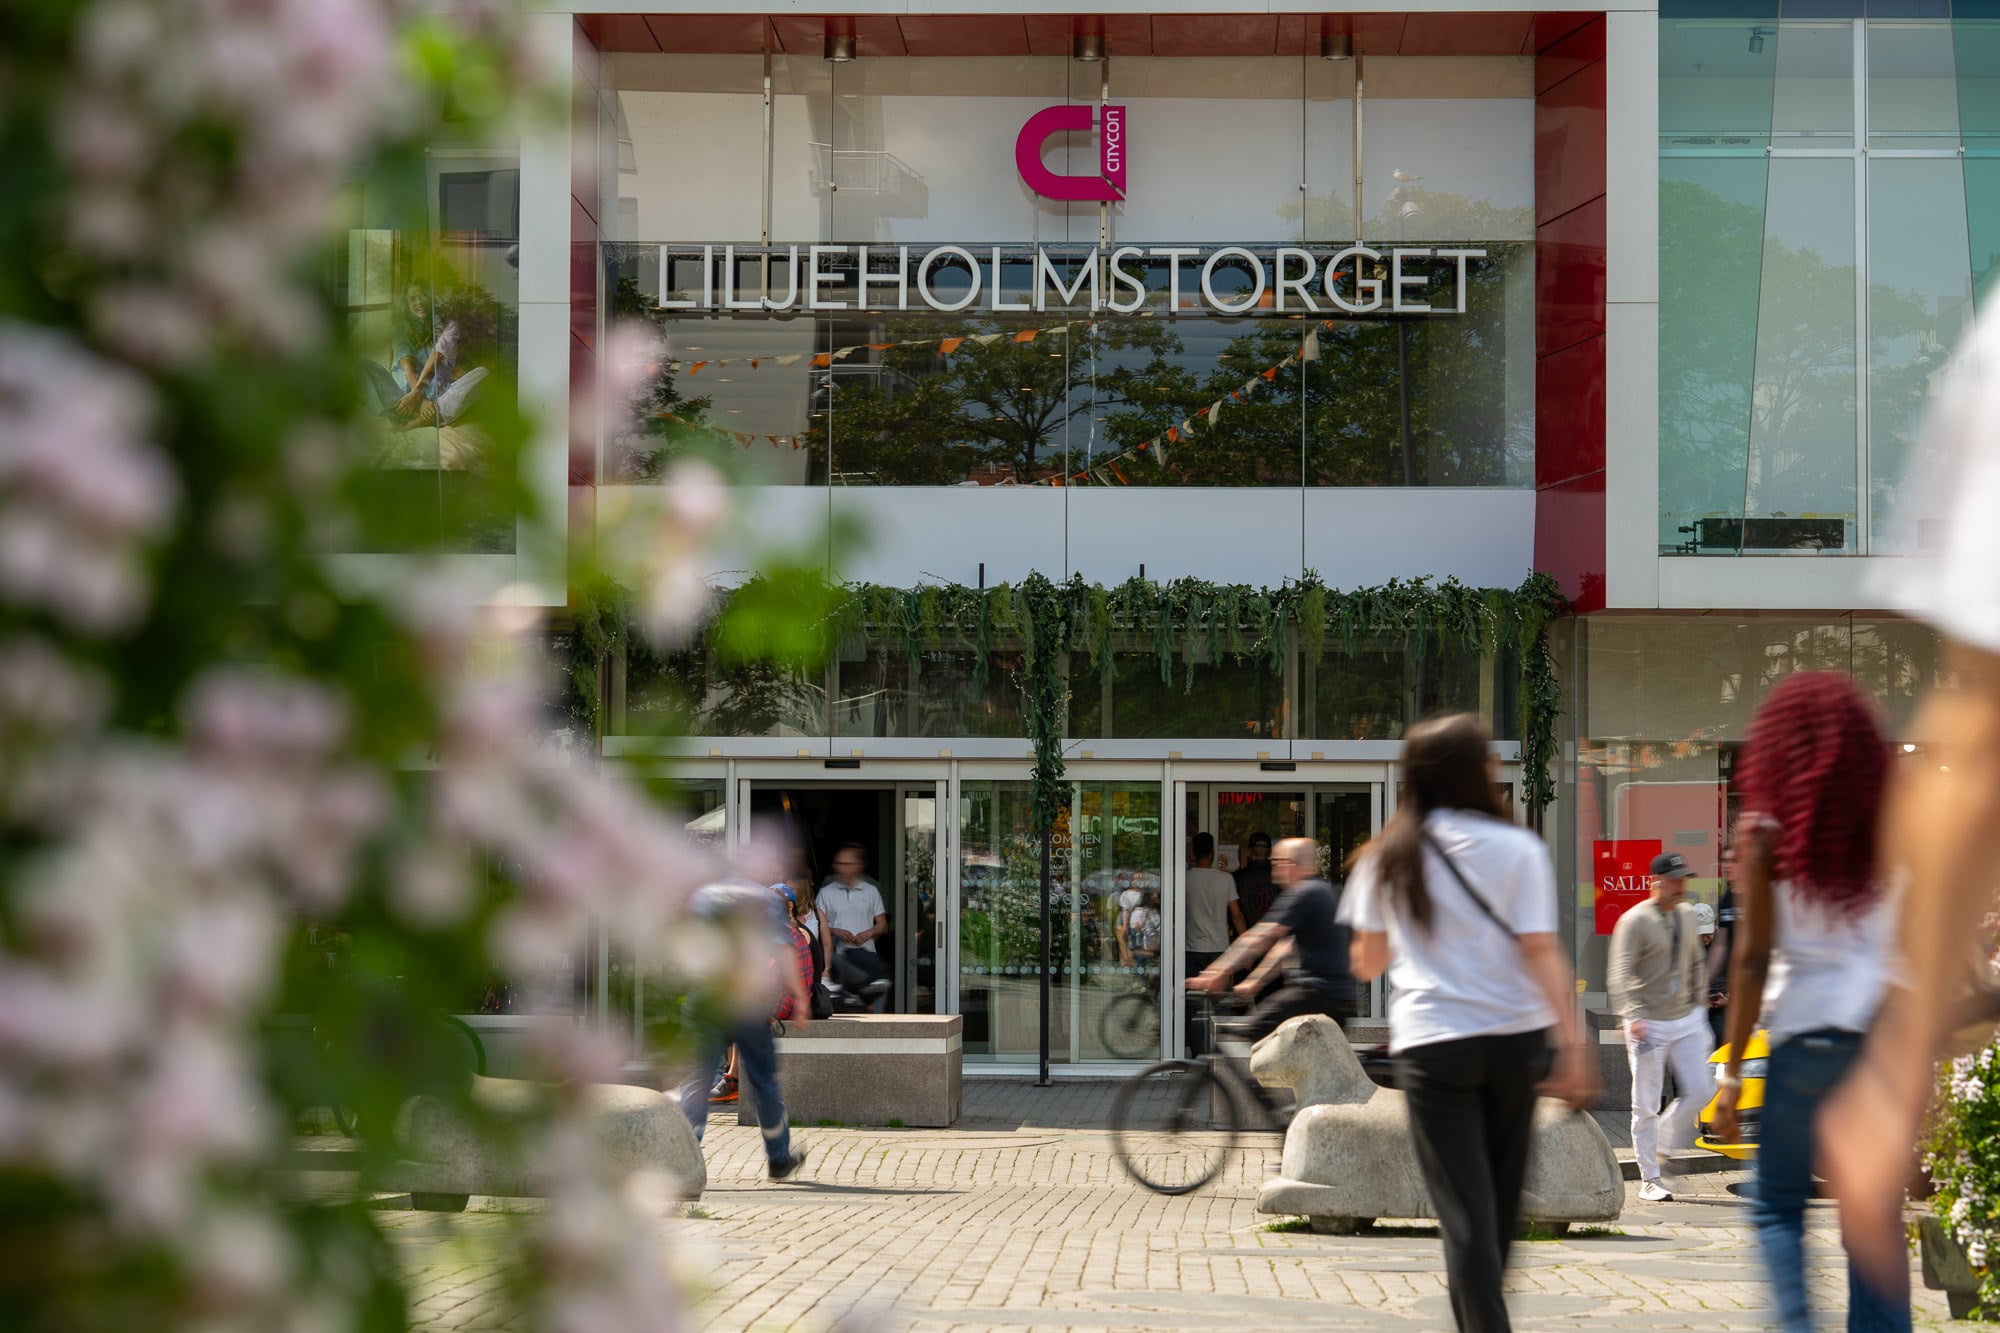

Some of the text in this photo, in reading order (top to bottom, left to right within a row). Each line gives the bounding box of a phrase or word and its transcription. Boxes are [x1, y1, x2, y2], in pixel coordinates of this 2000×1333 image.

[1106, 110, 1120, 173] CITYCON
[658, 245, 1487, 313] LILJEHOLMSTORGET
[1029, 847, 1093, 859] WLCOME
[1603, 875, 1653, 892] SALE
